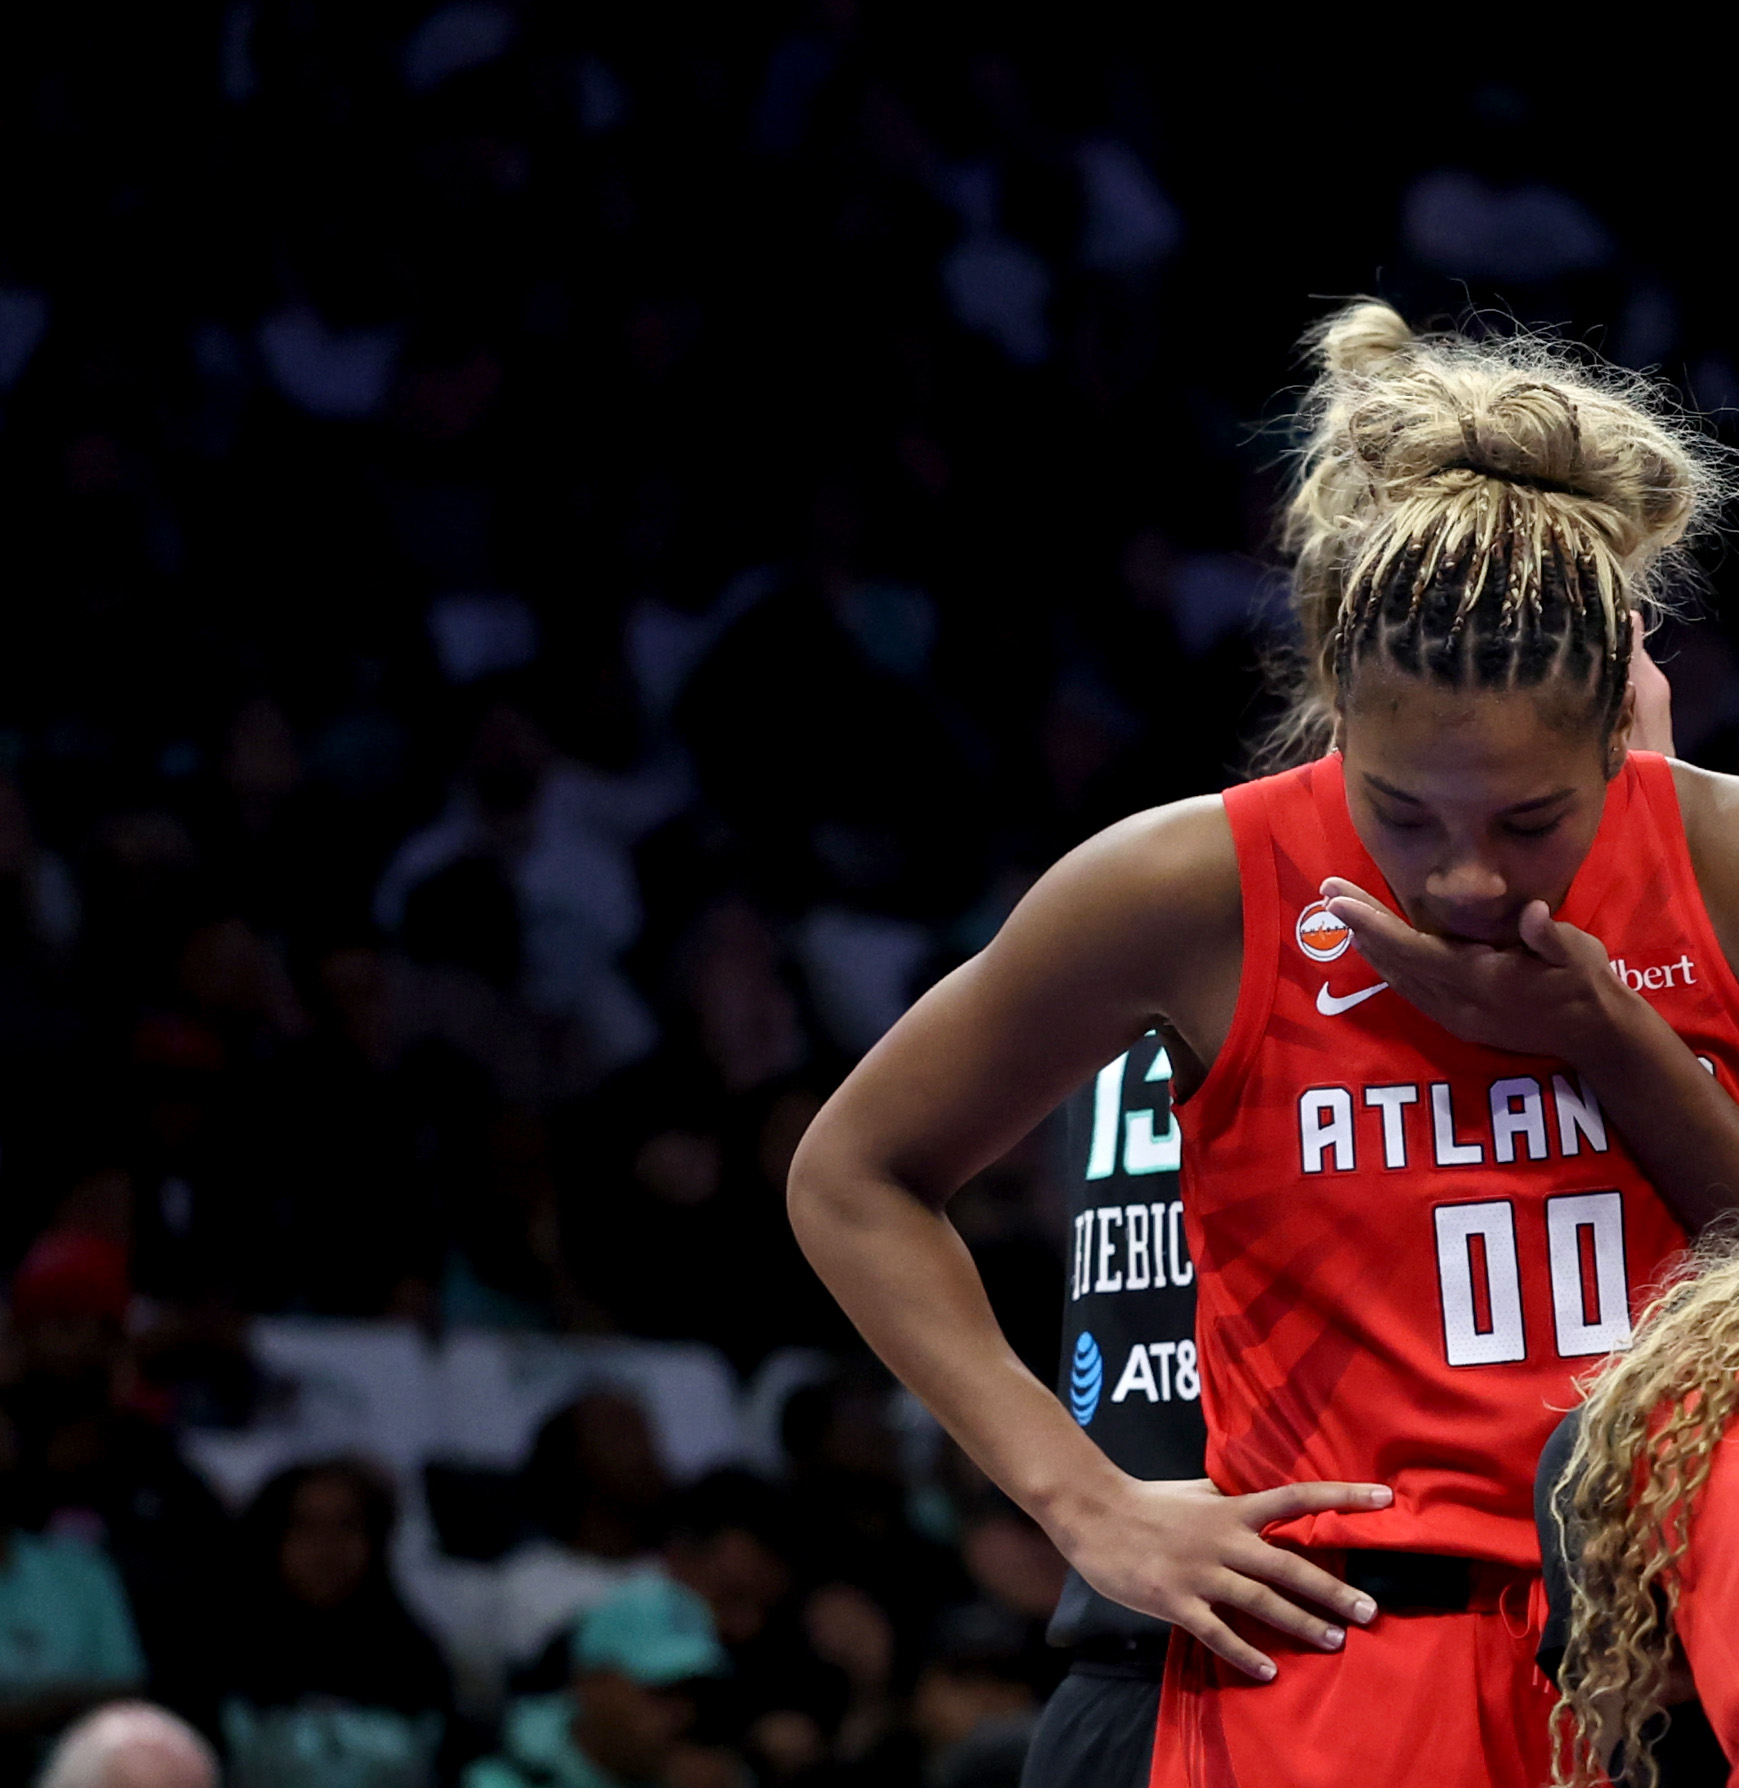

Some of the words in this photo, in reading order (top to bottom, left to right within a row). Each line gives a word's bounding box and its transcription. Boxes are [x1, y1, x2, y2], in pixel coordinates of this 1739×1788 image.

[1609, 955, 1698, 992] bert
[1299, 1056, 1714, 1173] ATLAN
[1434, 1191, 1633, 1367] 00
[1112, 1338, 1200, 1403] AT&
